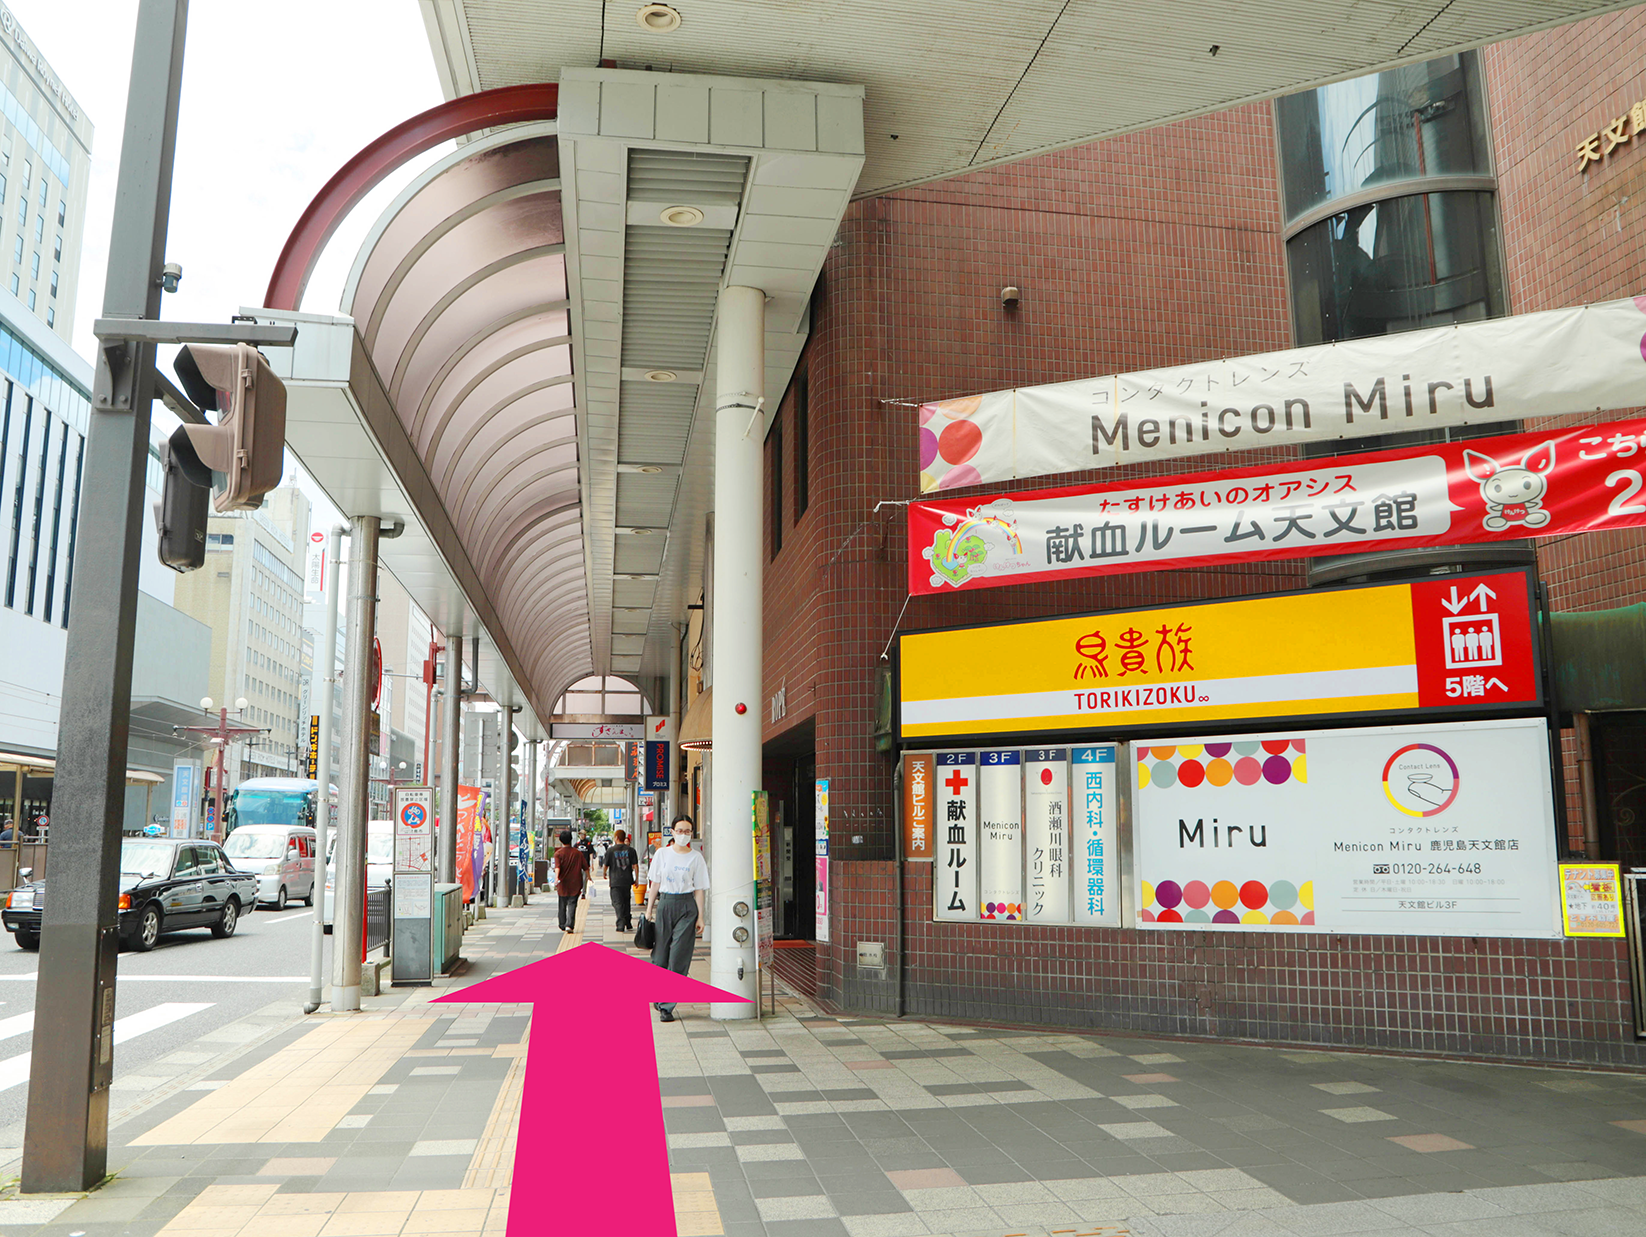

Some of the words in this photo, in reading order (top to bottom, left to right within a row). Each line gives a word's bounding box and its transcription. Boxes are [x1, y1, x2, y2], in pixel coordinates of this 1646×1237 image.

[1092, 360, 1310, 406] コンタクトレンズ
[1091, 396, 1312, 455] Menicon
[1343, 374, 1496, 424] Miru
[1579, 430, 1646, 460] こち
[1099, 474, 1358, 517] たすけあいのオアシス
[1045, 490, 1419, 565] 献血ルーム天文館
[1073, 622, 1195, 680] 鳥貴族
[1074, 685, 1196, 710] TORIKIZOKU
[1445, 675, 1509, 698] 5階へ
[656, 743, 665, 779] PROMISE
[946, 754, 967, 764] 2F
[989, 752, 1012, 764] 3F
[1038, 750, 1057, 761] 3F
[1081, 749, 1107, 762] 4F
[1398, 763, 1423, 771] Contact
[1425, 762, 1441, 770] Lens
[912, 761, 926, 851] 天文館ビルご案内
[983, 821, 1020, 830] Menicon
[990, 832, 1013, 840] Miru
[1048, 800, 1063, 878] 酒瀬川眼科
[1178, 818, 1267, 848] Miru
[1389, 826, 1459, 834] コンタクトレンズ
[947, 800, 967, 912] 献血ルーム
[1086, 771, 1105, 917] 西内科・循環器科
[1333, 841, 1384, 852] Menicon
[1389, 841, 1422, 851] Miru
[1430, 839, 1519, 851] 鹿児島天文館店
[1032, 847, 1045, 916] クリニック
[1392, 863, 1482, 875] 0120-264-648
[1398, 900, 1458, 910] 天文館ビル3F
